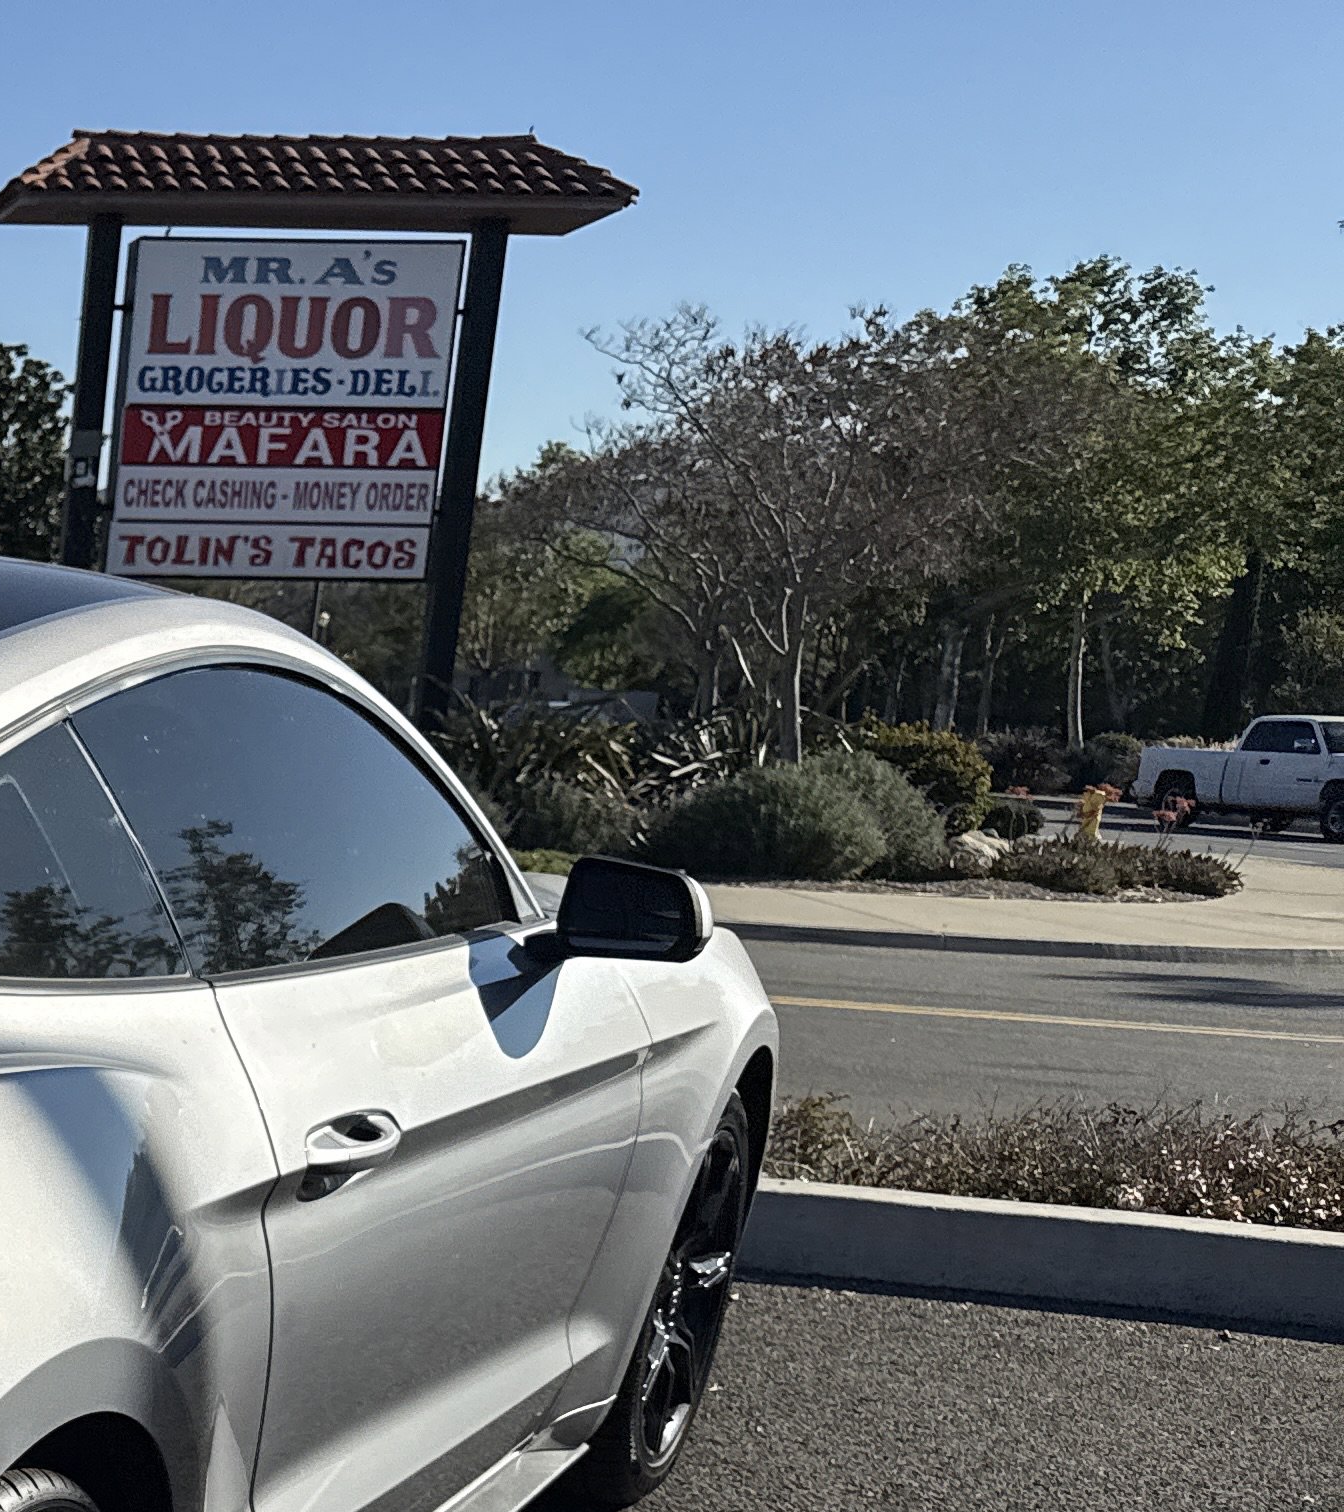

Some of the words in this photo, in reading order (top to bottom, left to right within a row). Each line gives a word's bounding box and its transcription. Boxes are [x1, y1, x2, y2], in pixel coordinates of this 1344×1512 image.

[147, 293, 440, 364] LIQUOR
[204, 411, 315, 427] BEAUTY
[322, 412, 418, 430] SALON
[145, 424, 428, 467] MAFARA
[123, 478, 188, 509] CHECK
[193, 479, 277, 510] CASHING
[292, 480, 361, 511] MONEY
[365, 481, 430, 512] ORDER
[118, 534, 273, 567] TOLIN'S
[289, 536, 418, 570] TACOS
